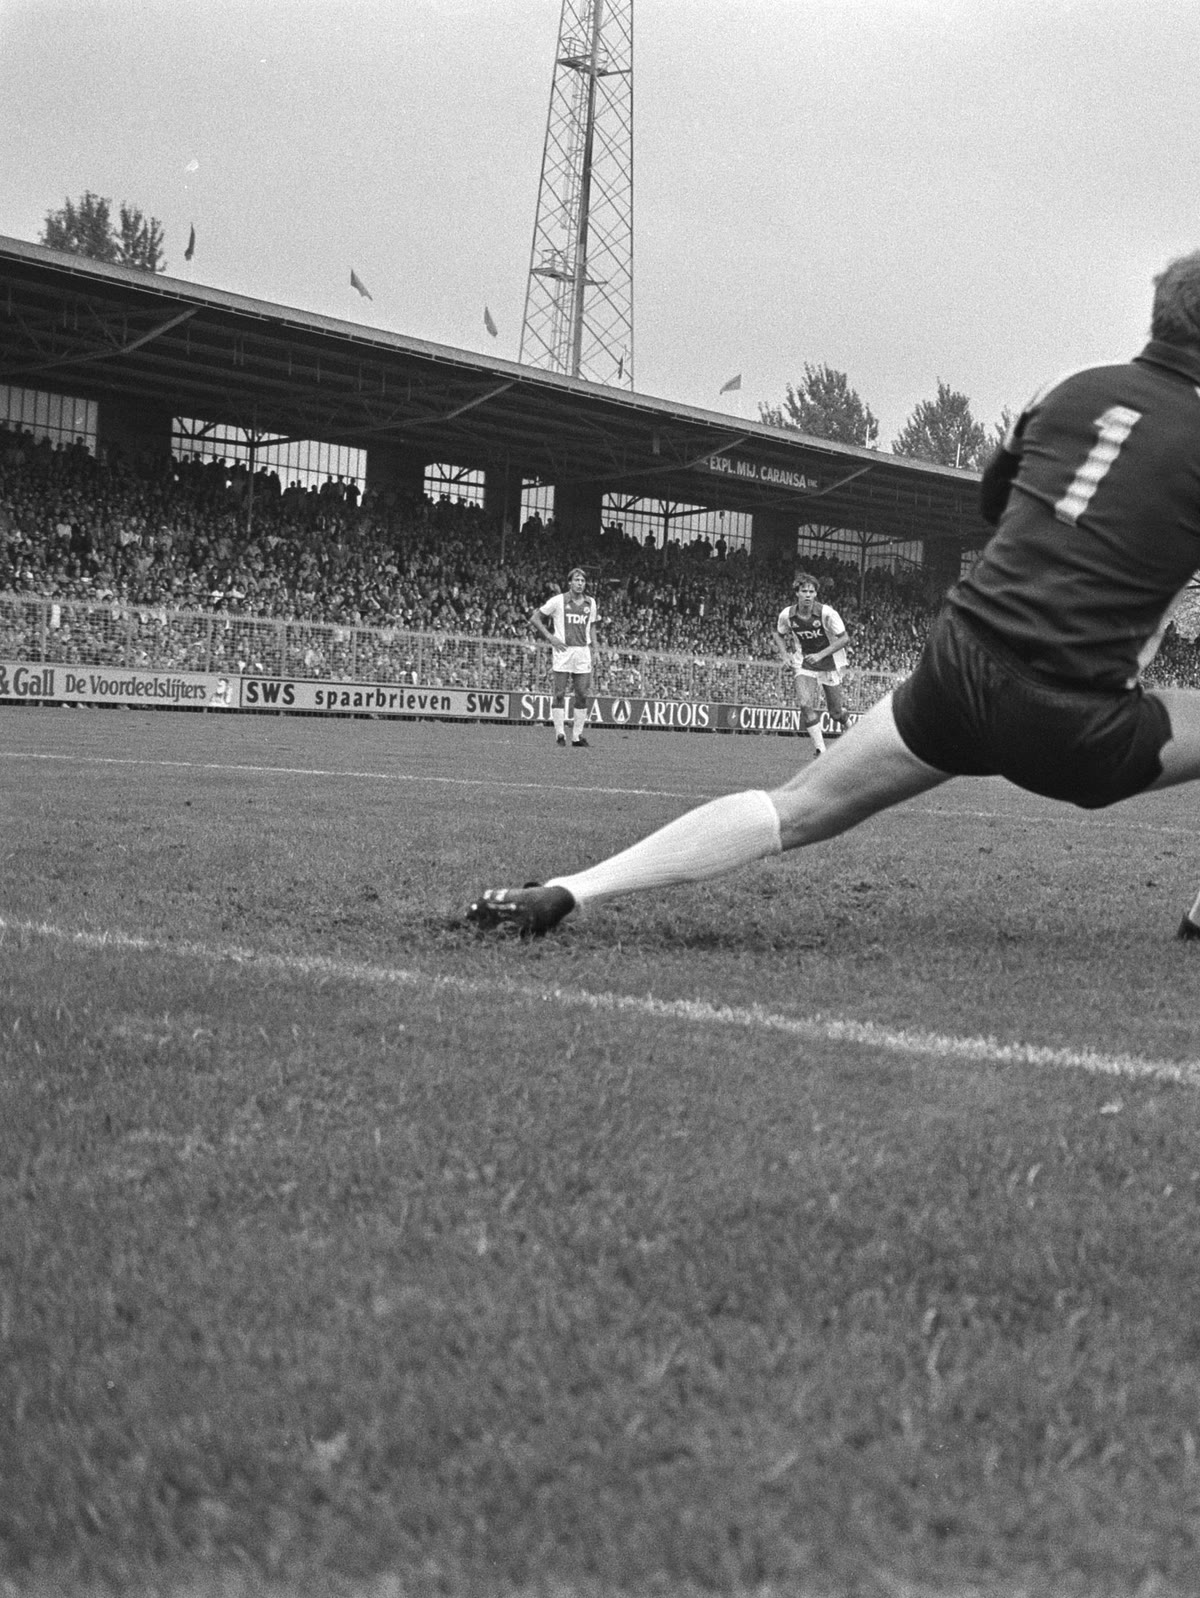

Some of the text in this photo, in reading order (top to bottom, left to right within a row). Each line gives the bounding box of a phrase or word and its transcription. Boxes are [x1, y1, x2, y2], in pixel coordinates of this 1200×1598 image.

[760, 466, 806, 488] CARANSA
[1093, 405, 1143, 527] 1
[565, 613, 588, 625] TDK
[797, 629, 823, 640] TDK
[13, 667, 55, 697] Gall
[65, 674, 207, 702] De Voordeelslijters
[247, 682, 505, 714] SWS spaarbrieven SWS
[521, 695, 709, 727] STLA ARTOIS
[740, 707, 801, 730] CITIZEN
